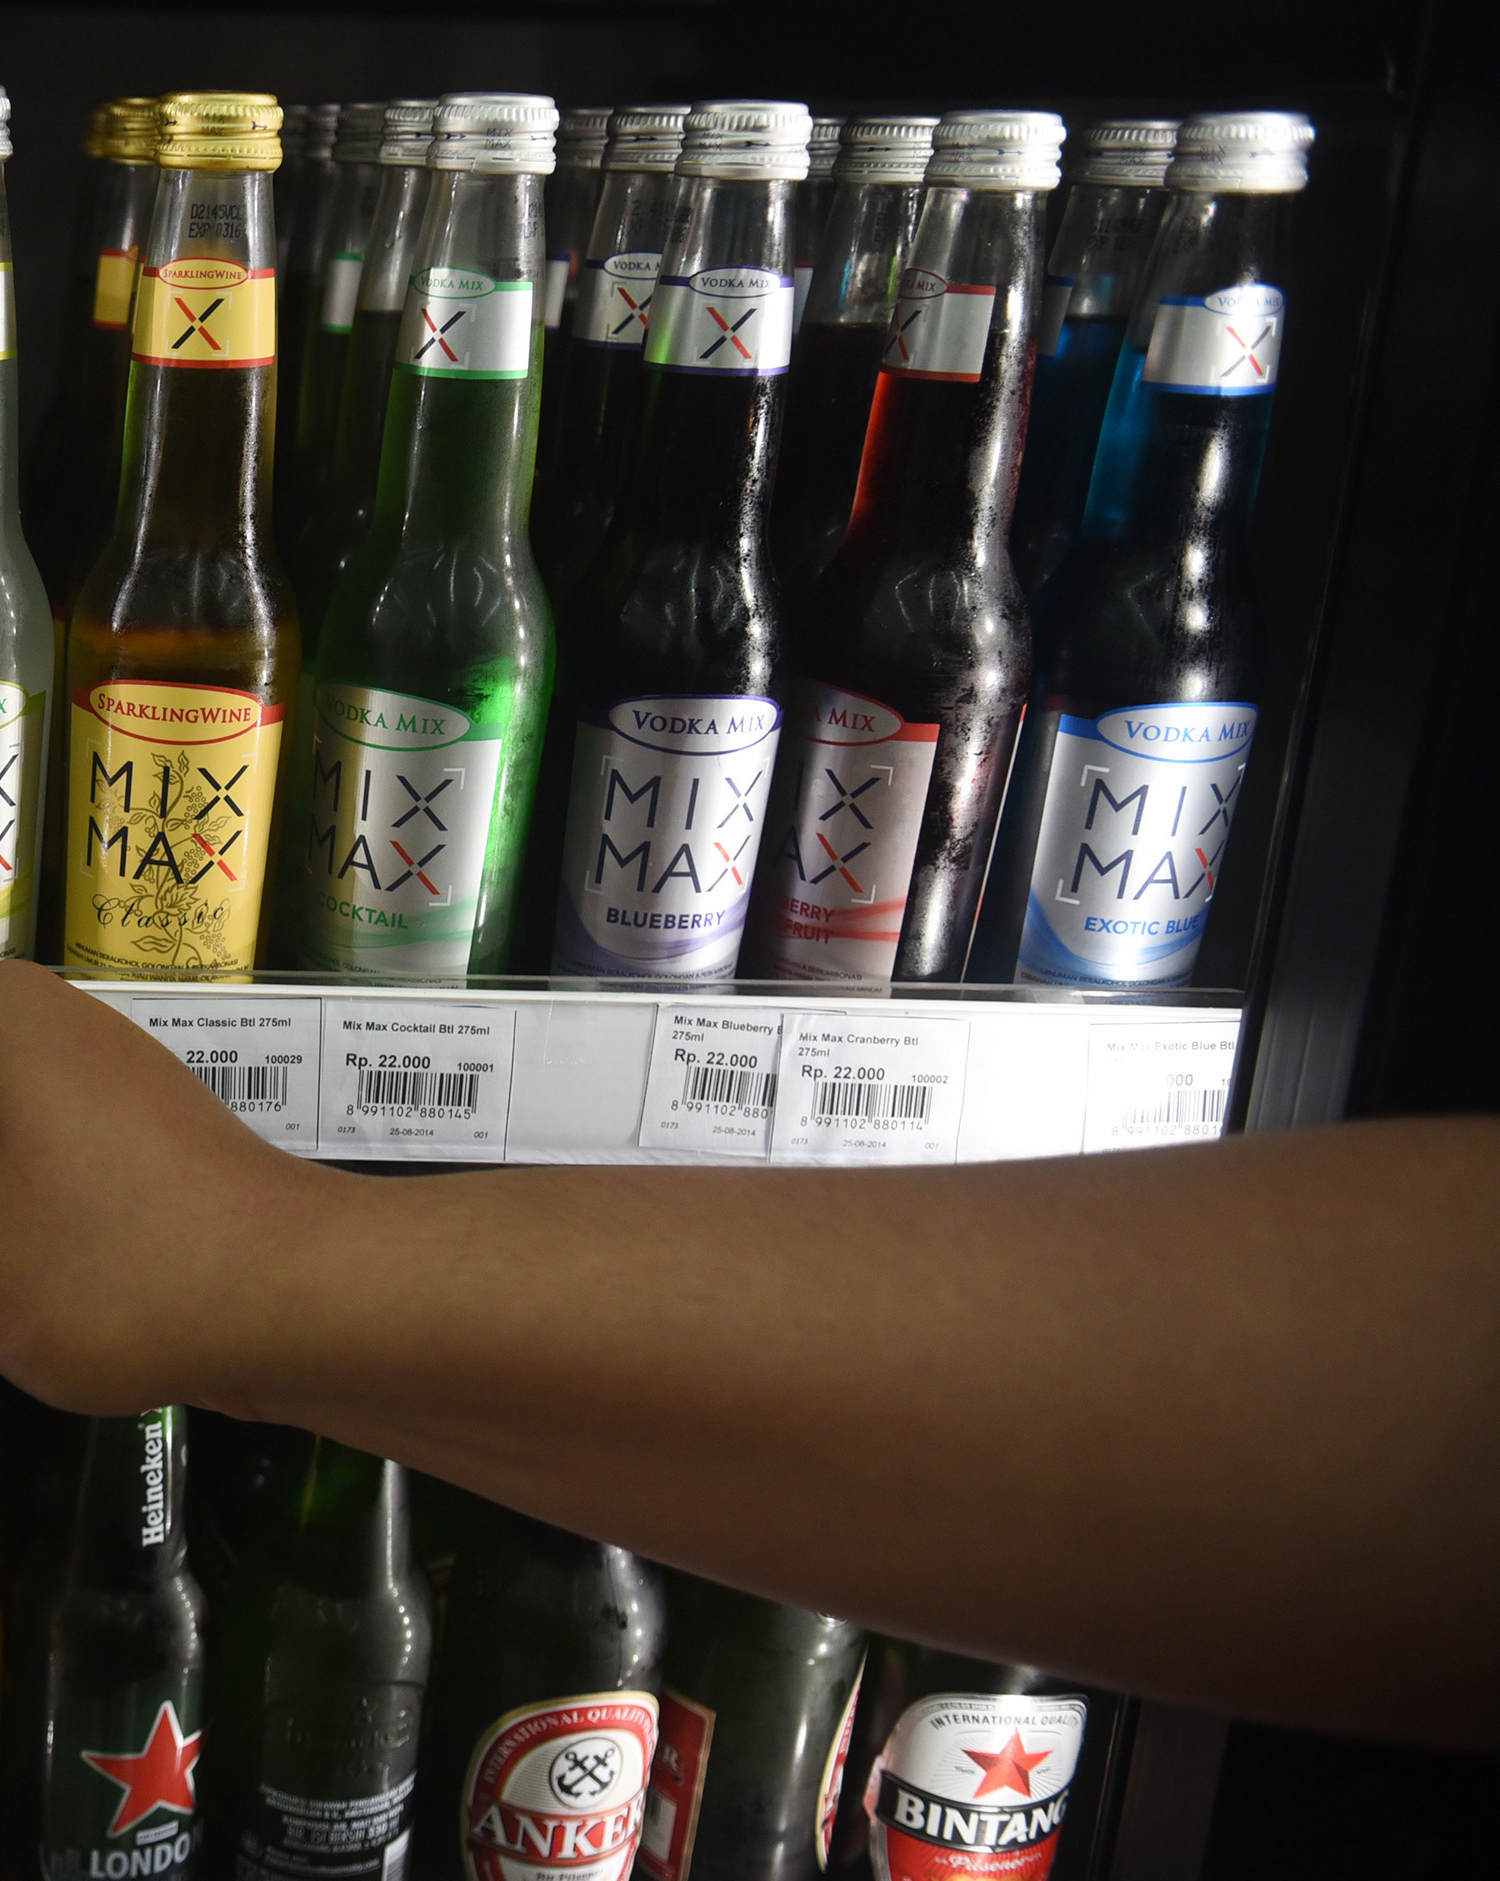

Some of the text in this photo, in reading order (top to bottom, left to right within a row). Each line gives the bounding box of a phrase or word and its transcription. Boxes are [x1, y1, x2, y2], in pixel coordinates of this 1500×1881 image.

[189, 223, 211, 238] EXP
[421, 276, 484, 292] VODKA MIX
[701, 277, 771, 289] VODKA MIX
[326, 693, 447, 736] VODKA MIX
[632, 709, 766, 735] VODKA MIX
[828, 708, 876, 733] MIX
[1124, 720, 1251, 743] VODKA MIX
[90, 751, 250, 821] MIX
[313, 750, 455, 832] MIX
[604, 768, 763, 830] MIX
[1084, 770, 1243, 837] MIX
[86, 815, 243, 885] MAX
[309, 812, 448, 896] MAX
[595, 833, 752, 894] MAX
[1071, 840, 1226, 901] MAX
[92, 894, 225, 930] Classic
[317, 891, 409, 930] COCKTAIL
[606, 907, 726, 930] BLUEBERRY
[1084, 914, 1200, 936] EXOTIC BLUE
[149, 1018, 291, 1028] Mix Max Classic Btl 275ml
[342, 1021, 490, 1036] Mix Max Cocktail Btl 275ml
[674, 1016, 773, 1036] Mix Max Blueberry
[672, 1030, 705, 1042] 275ml
[799, 1033, 919, 1048] Mix Max Cranberry Btl
[1155, 1041, 1235, 1051] Exotic Blue Btl
[186, 1051, 303, 1065] 22.000 100029
[345, 1053, 494, 1072] Rp. 22.000 100001
[674, 1048, 758, 1069] Rp. 22.000
[798, 1047, 830, 1057] 275ml
[802, 1065, 949, 1085] Rp. 22.000 100002
[231, 1101, 282, 1113] 880176
[362, 1106, 471, 1120] 991102 880145
[686, 1101, 737, 1117] 991102
[285, 1123, 300, 1131] 001
[140, 1420, 165, 1548] Heineken
[930, 1713, 1037, 1730] INTERNATIONAL
[485, 1712, 585, 1783] INTERNATIONAL
[894, 1789, 1069, 1846] BINTANG
[91, 1833, 191, 1880] LONDO
